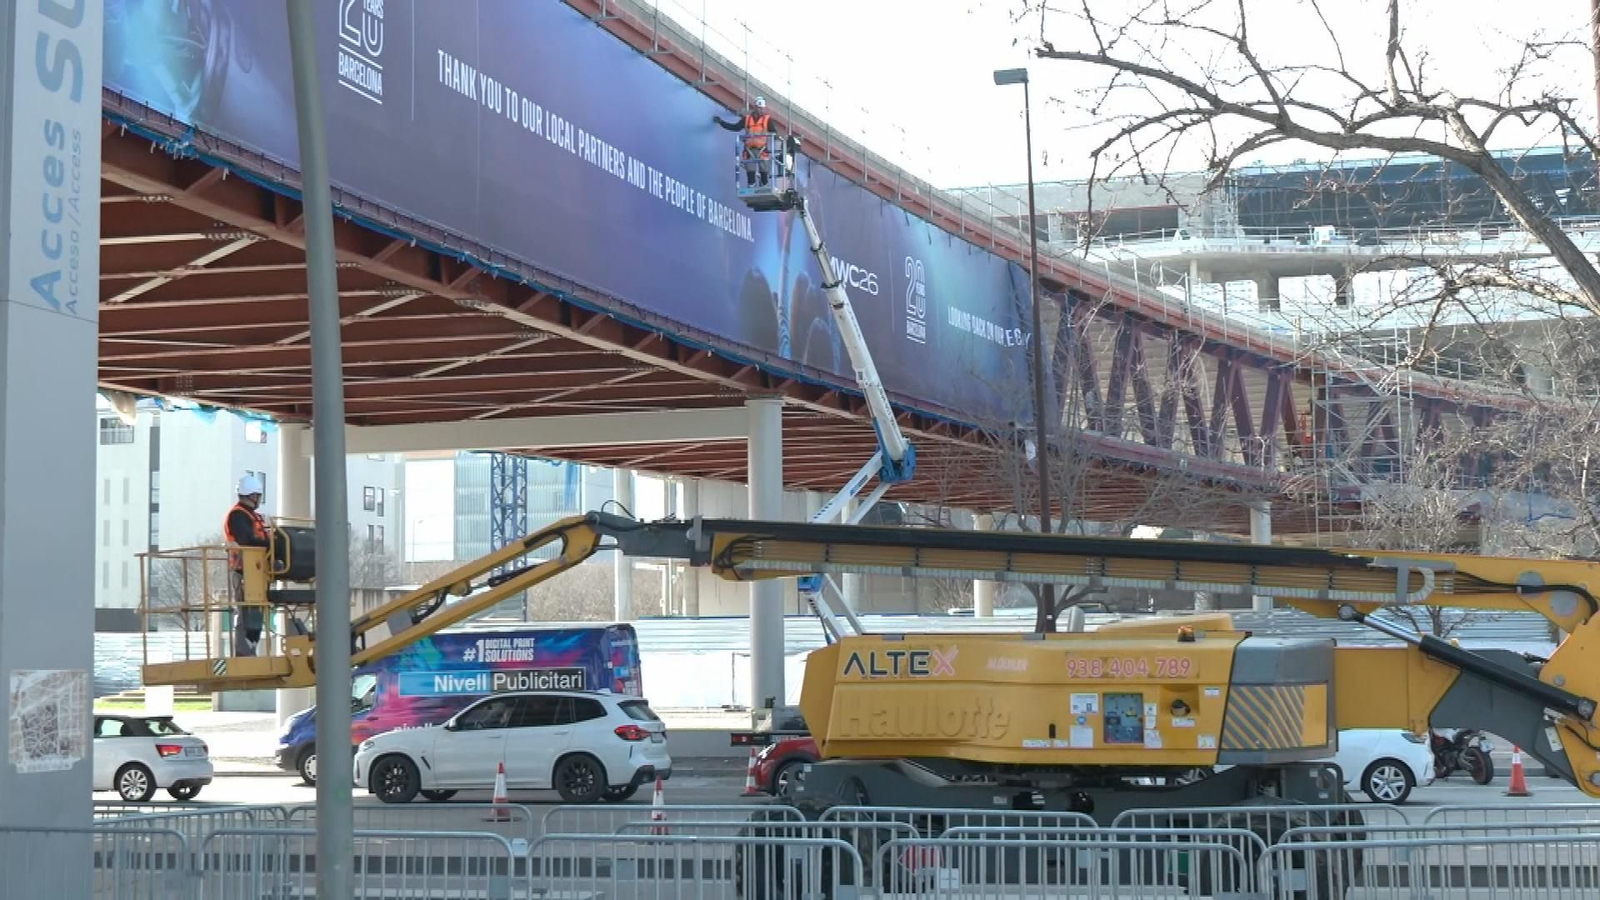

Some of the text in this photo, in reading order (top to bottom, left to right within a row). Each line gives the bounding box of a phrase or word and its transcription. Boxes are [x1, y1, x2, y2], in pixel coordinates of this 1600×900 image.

[338, 51, 383, 96] BARCELONA
[437, 49, 755, 243] THANK YOU TO OUR LOCAL PARTNERS AND THE PEOPLE OF BARCELONA.
[485, 638, 511, 649] DIGITAL
[512, 637, 535, 648] PRINT
[485, 648, 534, 663] SOLUTIONS
[843, 645, 960, 677] ALTEX
[1066, 656, 1192, 678] 938 404 789
[434, 670, 583, 692] Nivell Publicitari
